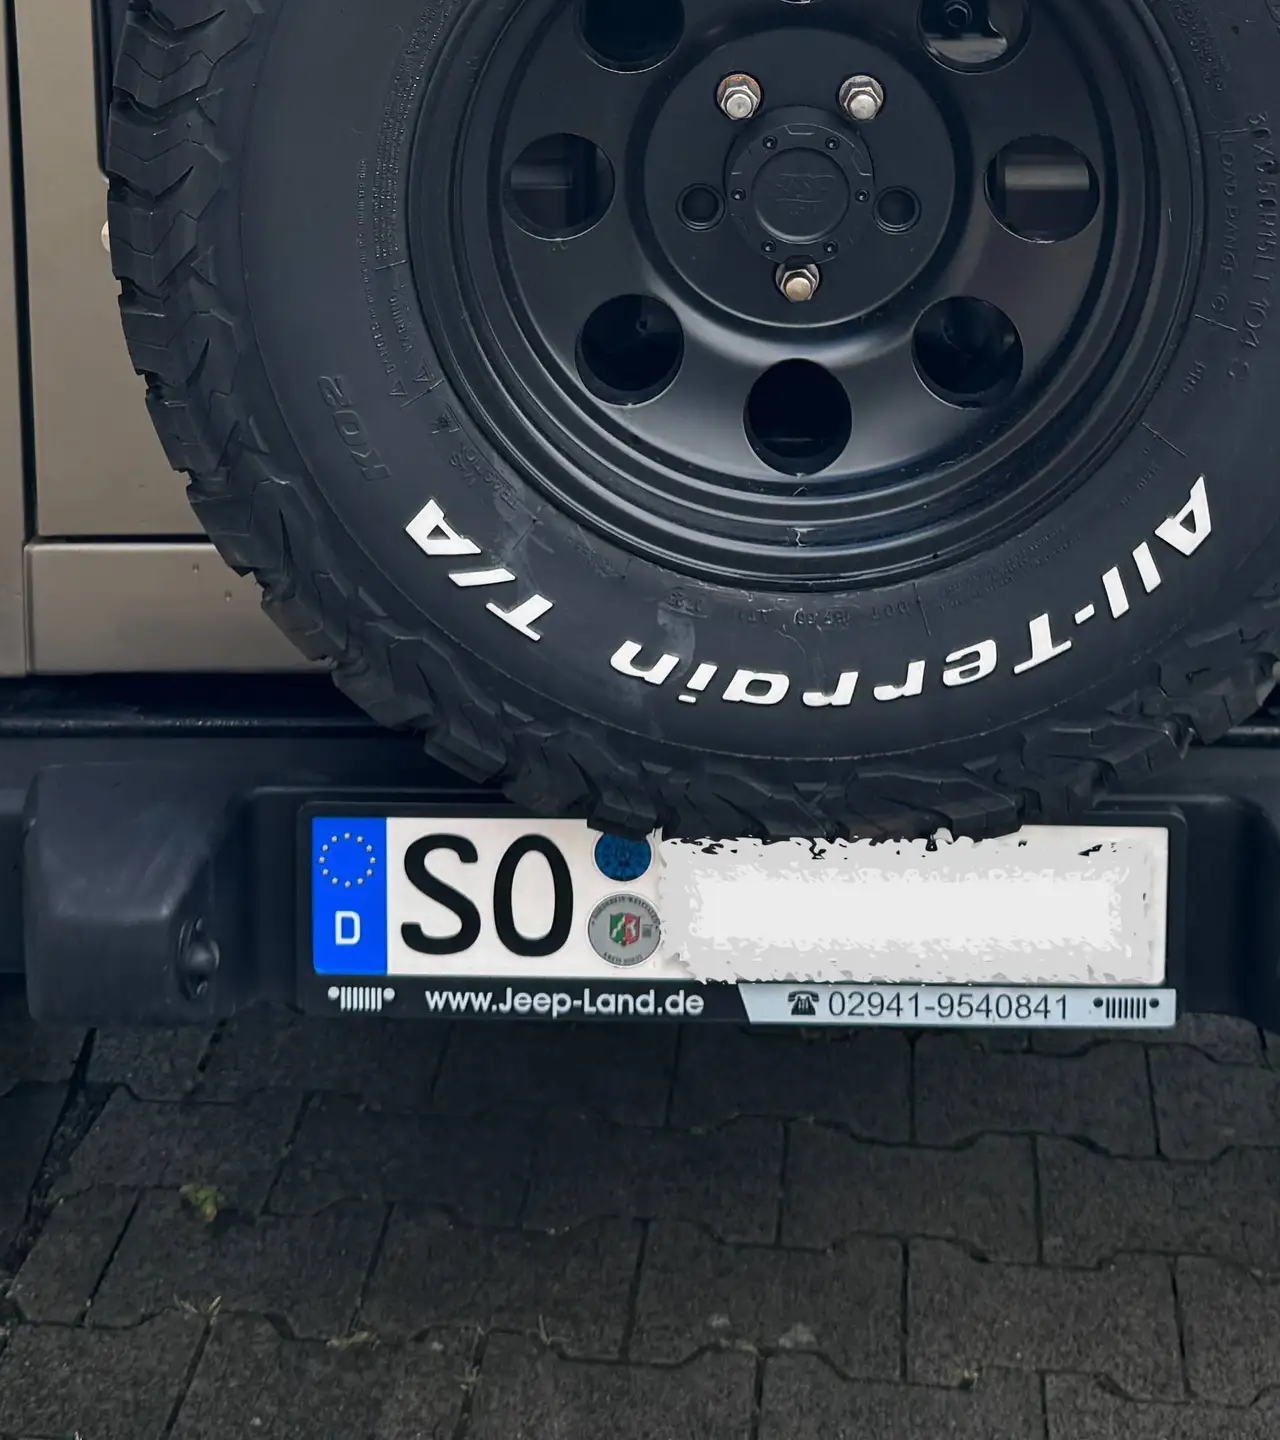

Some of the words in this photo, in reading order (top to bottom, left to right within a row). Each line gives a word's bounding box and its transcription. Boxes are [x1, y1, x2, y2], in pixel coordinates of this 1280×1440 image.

[317, 375, 393, 482] KO2
[404, 497, 555, 641] T/A
[608, 475, 1212, 707] All-Terrain
[334, 910, 362, 946] D
[400, 833, 575, 957] SO
[425, 985, 706, 1018] www.Jeep-Land.de
[828, 991, 1070, 1021] 02941-9540841
